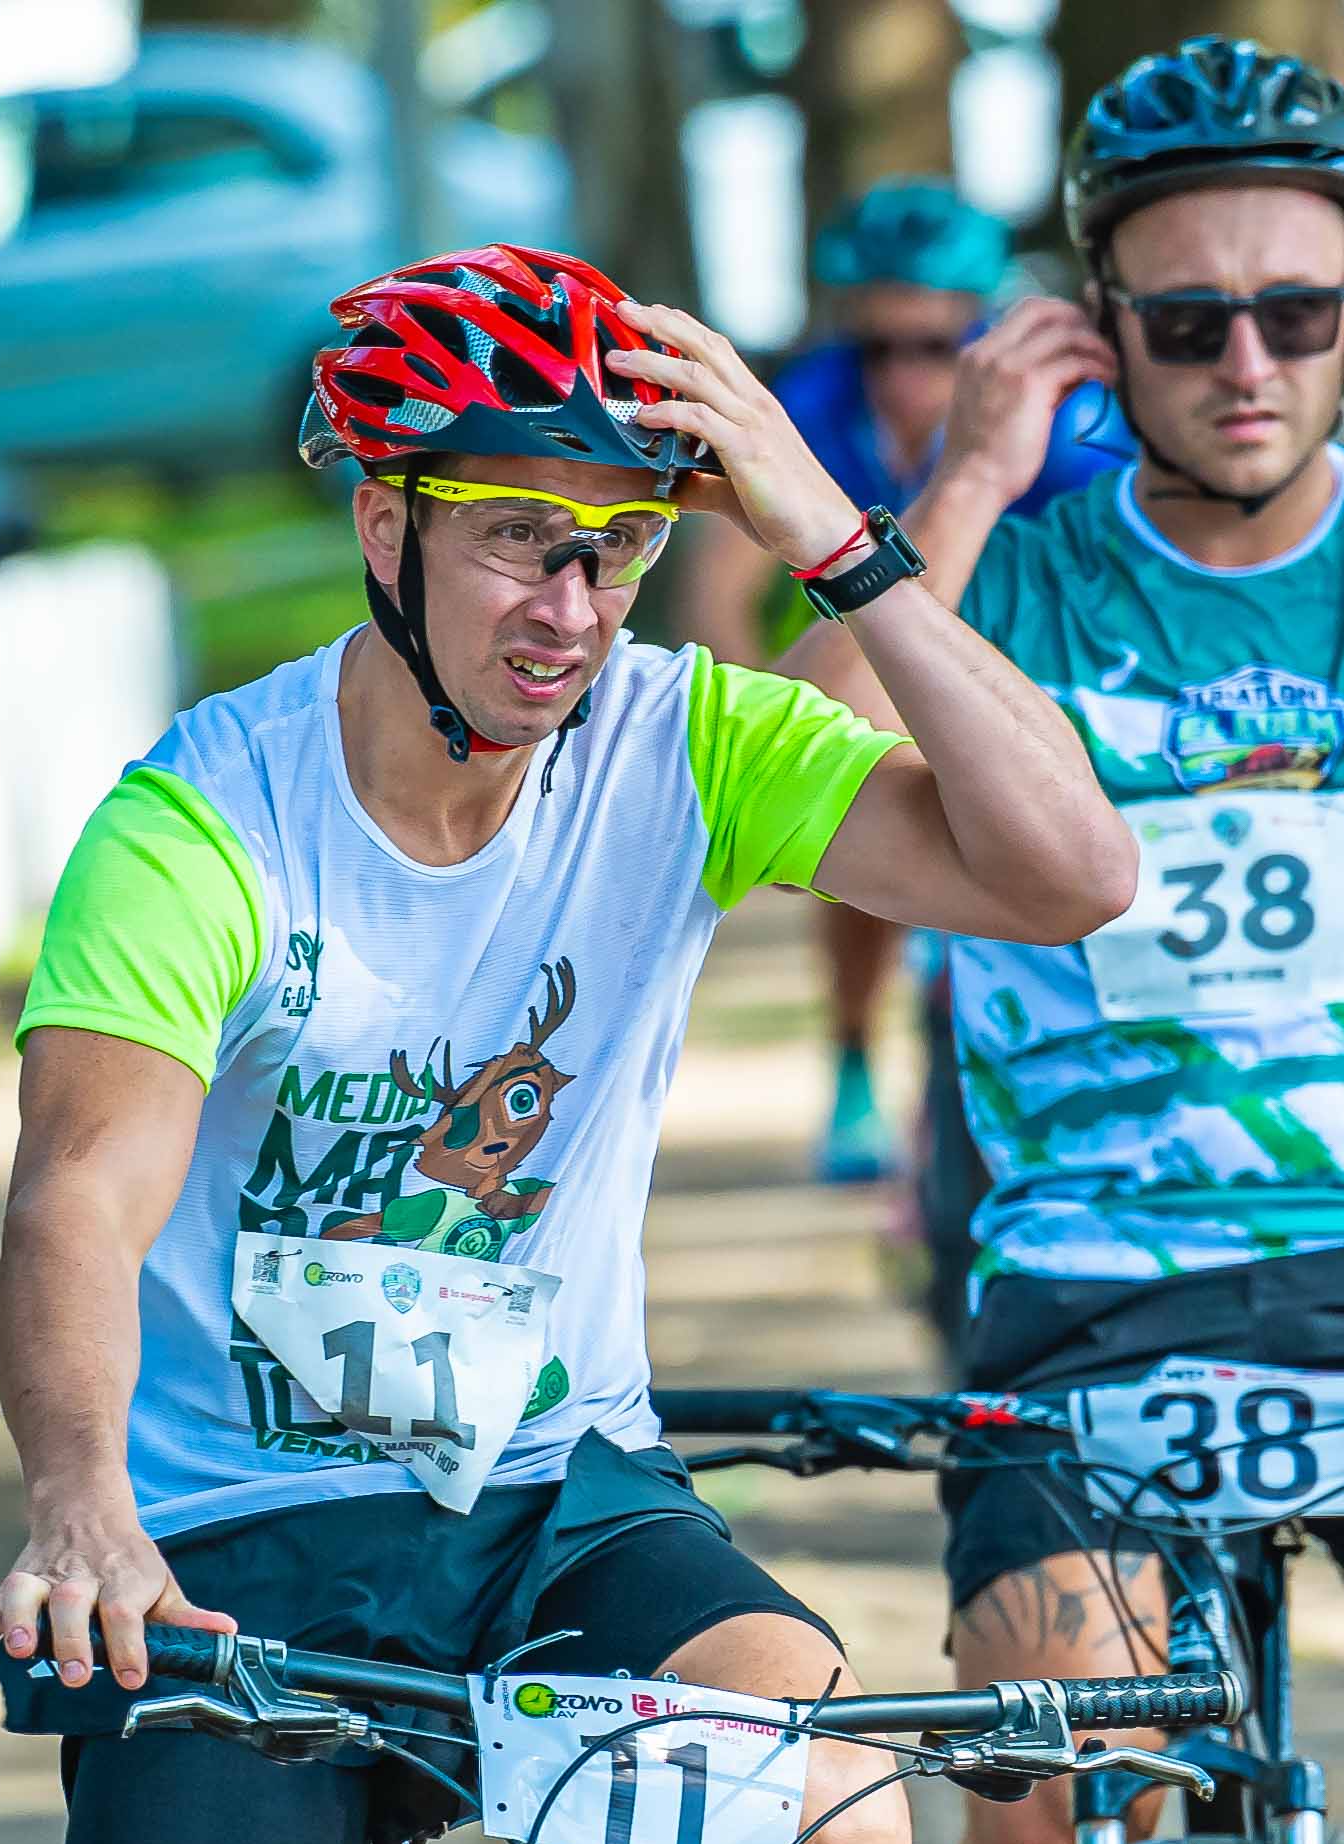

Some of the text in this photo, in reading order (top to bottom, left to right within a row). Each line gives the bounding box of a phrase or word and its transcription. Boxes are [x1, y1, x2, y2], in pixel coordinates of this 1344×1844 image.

[1158, 853, 1315, 960] 38
[322, 1320, 476, 1451] 11
[1140, 1387, 1318, 1502] 38
